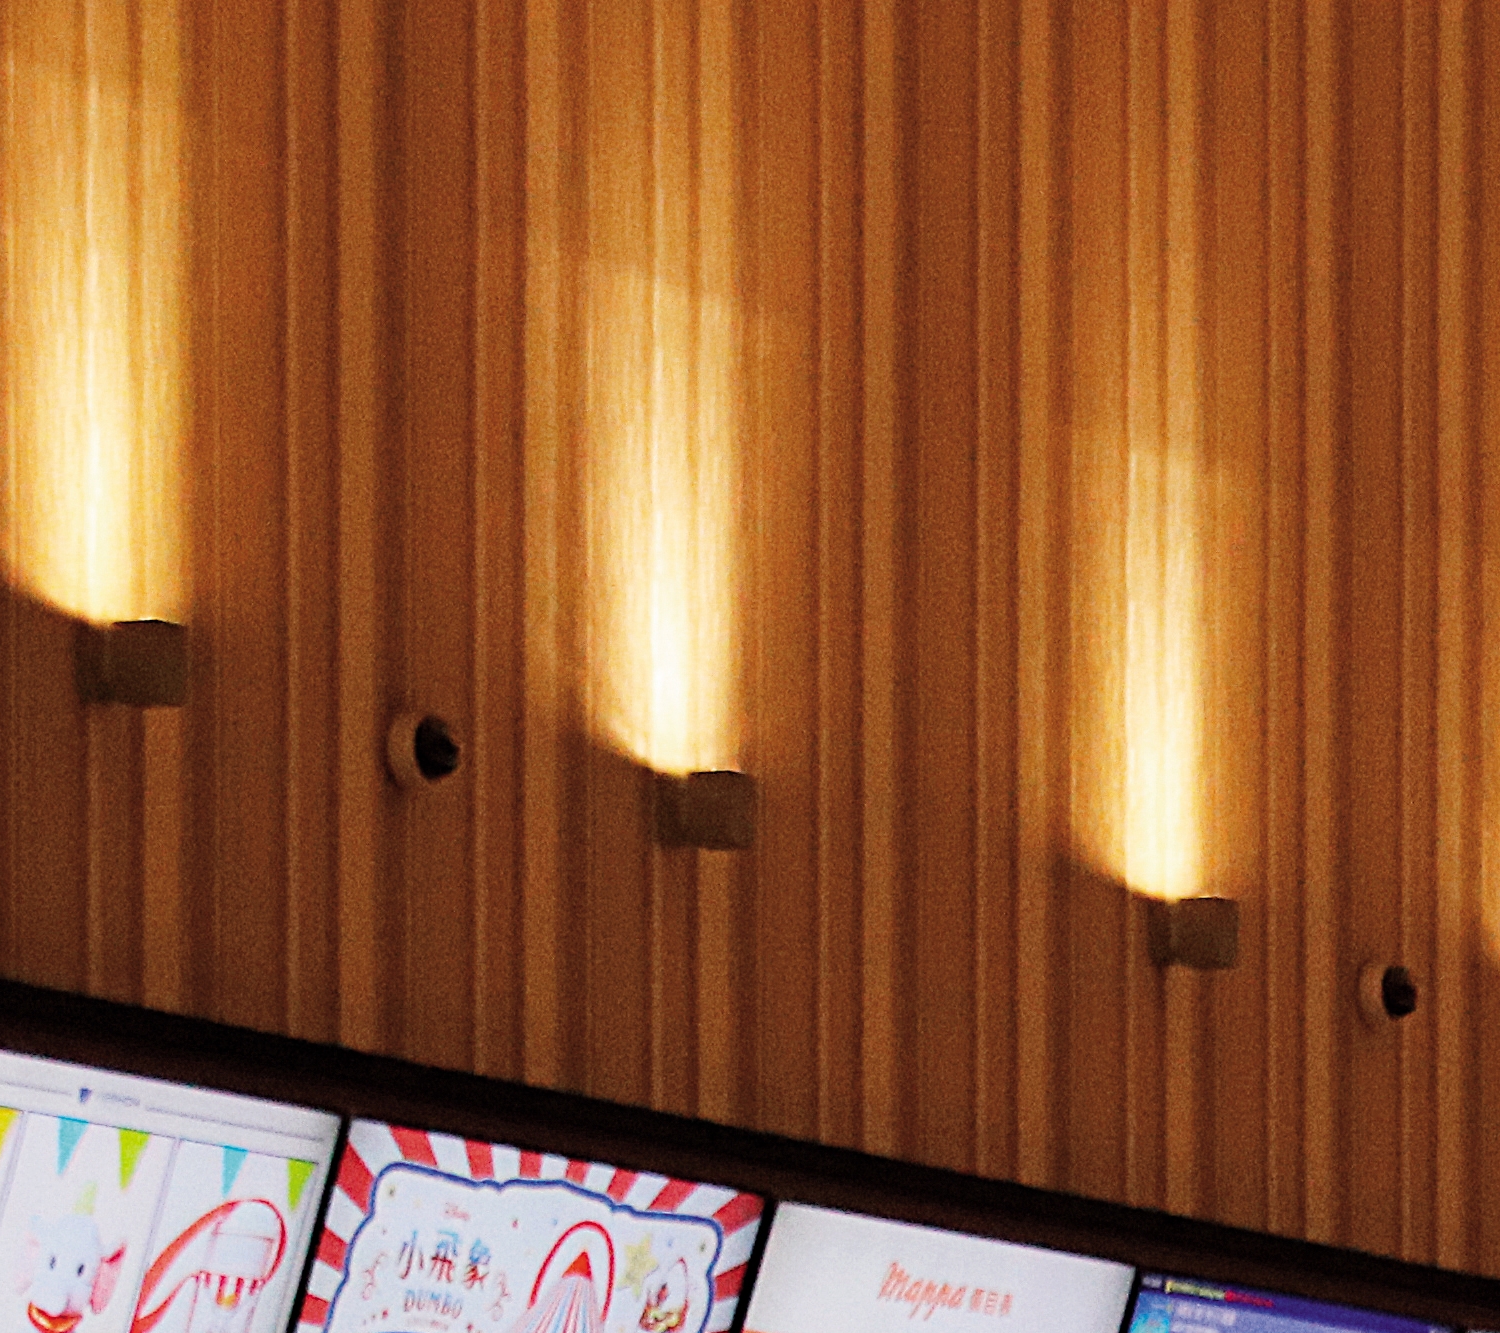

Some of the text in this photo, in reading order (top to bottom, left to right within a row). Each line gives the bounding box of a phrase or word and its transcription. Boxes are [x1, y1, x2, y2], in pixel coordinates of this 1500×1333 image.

[396, 1230, 493, 1289] 小飛象
[402, 1288, 464, 1321] DUMBO
